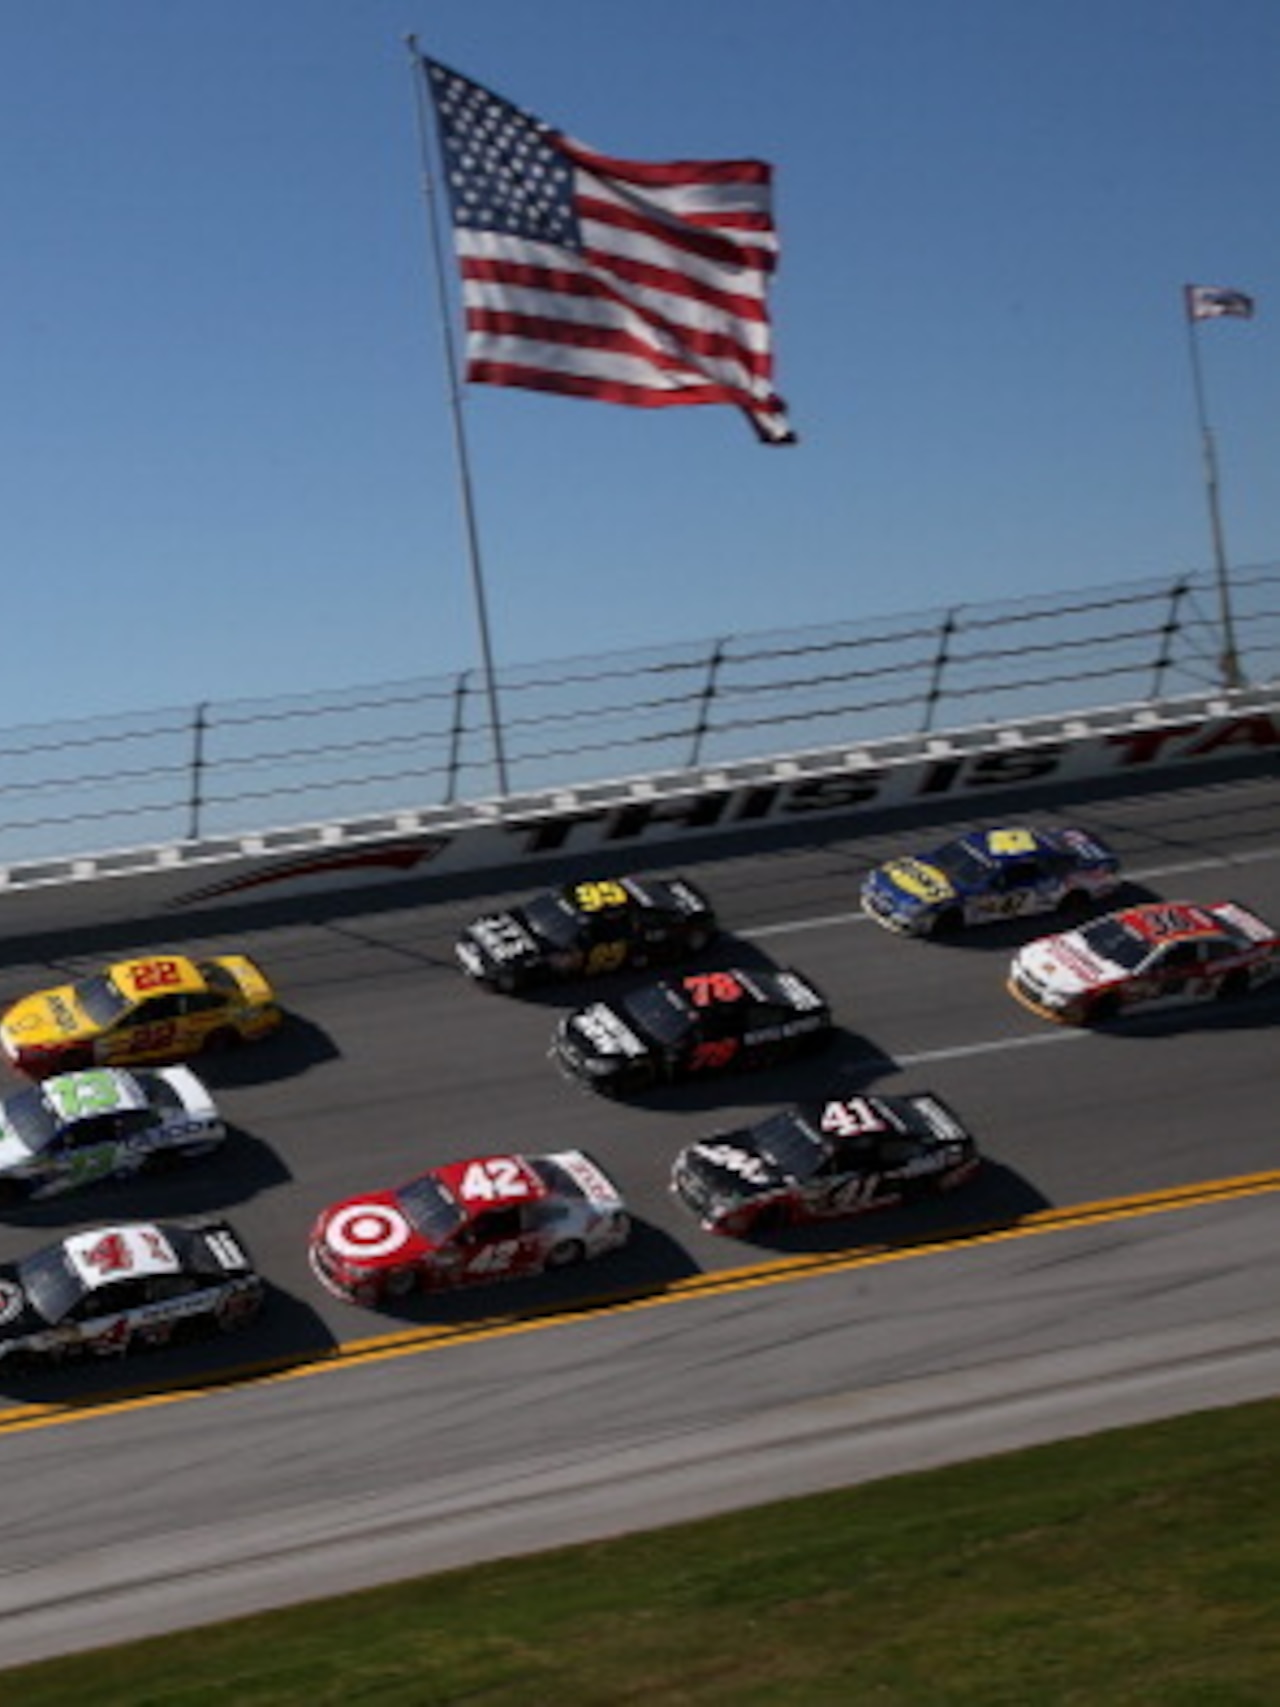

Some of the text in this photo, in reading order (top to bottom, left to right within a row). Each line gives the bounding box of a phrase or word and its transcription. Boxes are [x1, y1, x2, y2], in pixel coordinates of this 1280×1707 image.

[504, 768, 890, 851] THIS
[916, 744, 1062, 794] IS
[131, 961, 181, 990] 22
[683, 972, 742, 1007] 78
[821, 1097, 888, 1137] 41
[460, 1157, 528, 1201] 42
[84, 1233, 134, 1275] 4
[468, 1238, 520, 1273] 42
